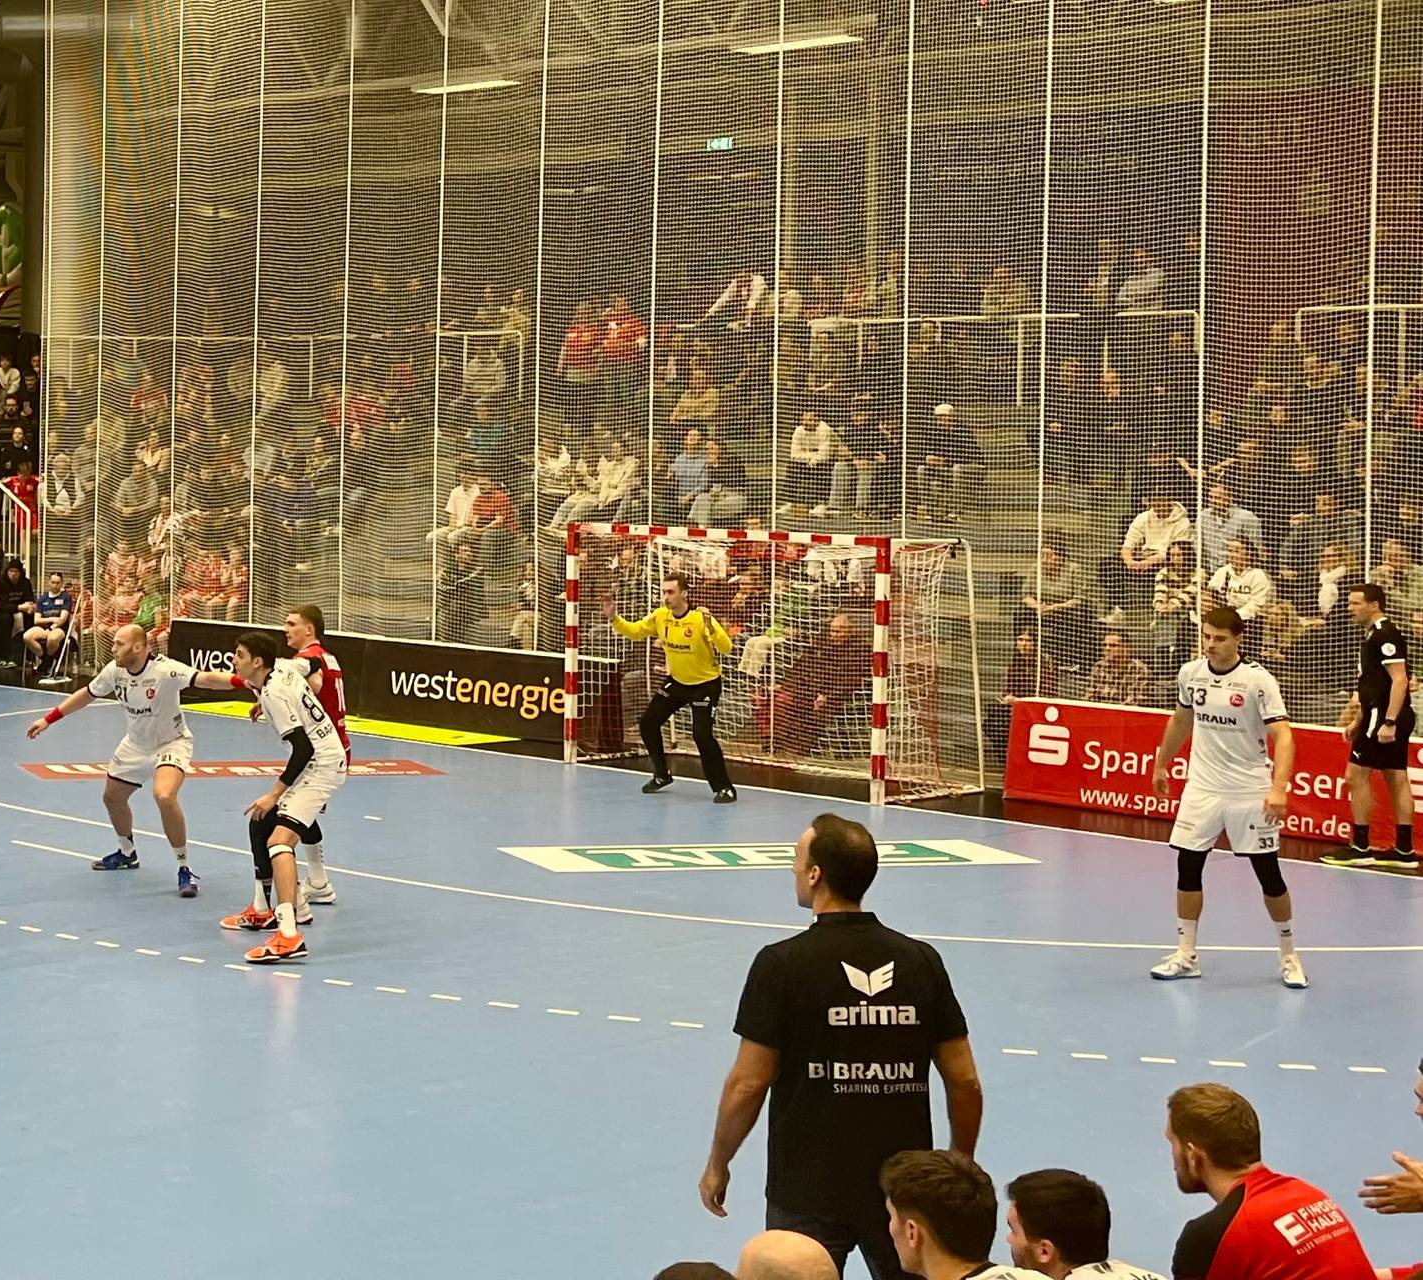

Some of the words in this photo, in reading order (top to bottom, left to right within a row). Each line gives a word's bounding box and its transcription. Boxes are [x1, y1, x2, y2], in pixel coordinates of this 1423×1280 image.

[391, 669, 566, 720] westenergie
[1187, 686, 1208, 706] 33
[1257, 836, 1275, 850] 33
[827, 1000, 917, 1026] erima
[833, 1061, 915, 1080] BRAUN
[833, 1083, 880, 1095] SHARING
[1306, 1210, 1345, 1233] HAUS
